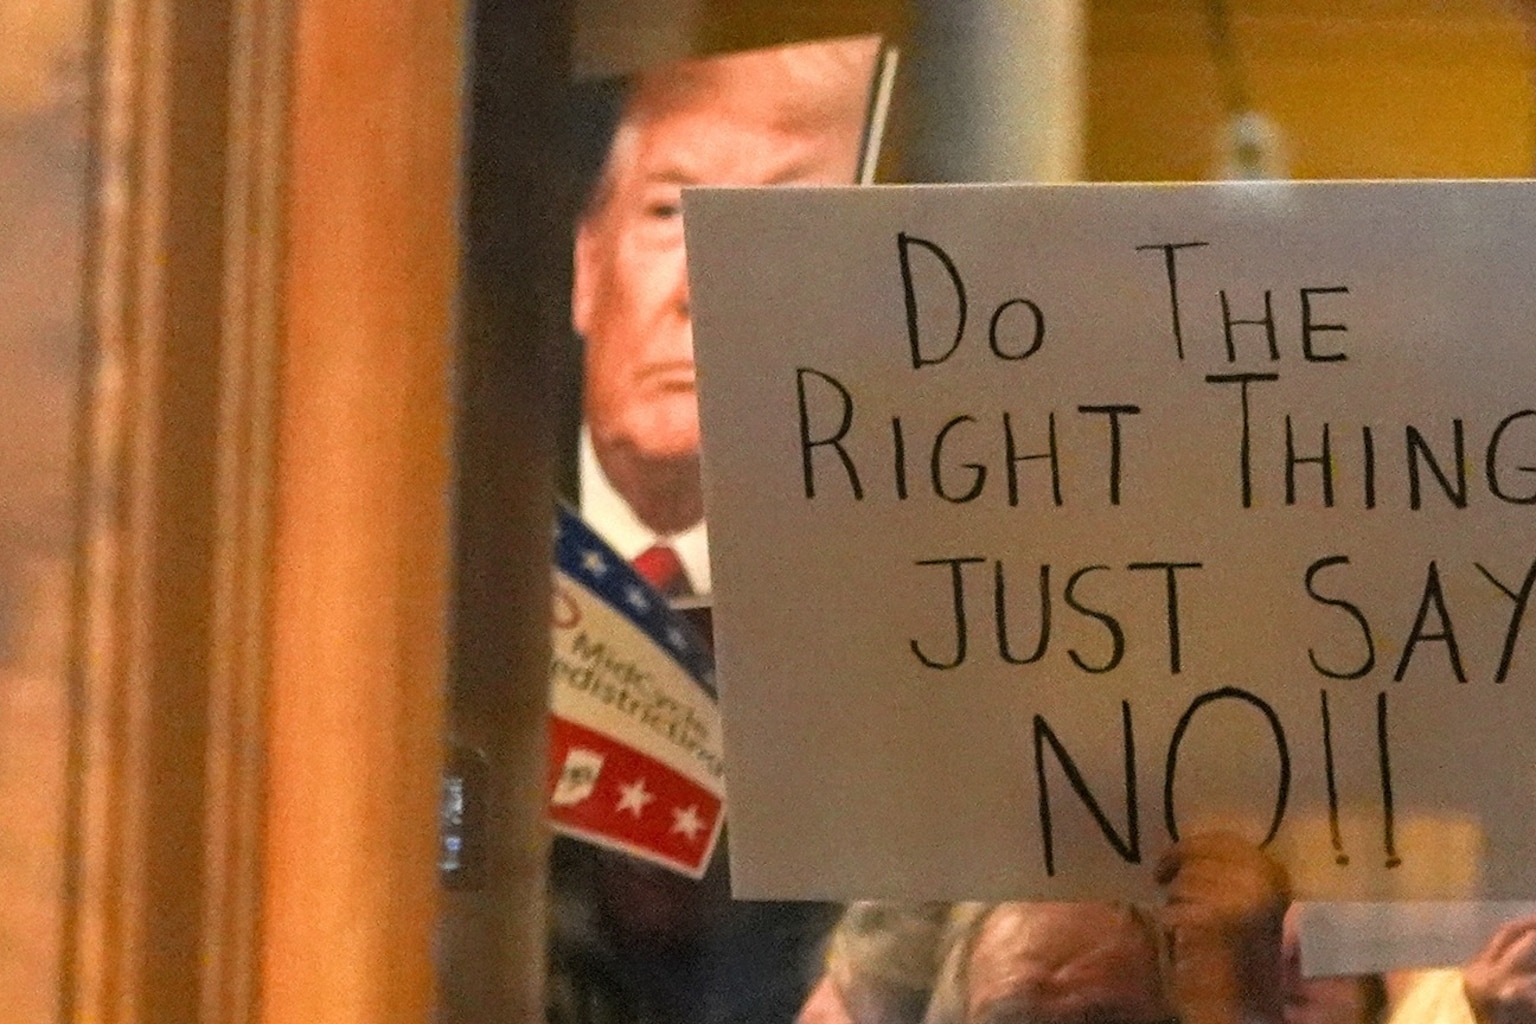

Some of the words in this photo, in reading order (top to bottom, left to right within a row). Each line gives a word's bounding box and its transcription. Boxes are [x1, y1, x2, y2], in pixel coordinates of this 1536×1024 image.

[1134, 239, 1352, 364] THE
[794, 366, 1142, 508] RIGHT
[909, 555, 1203, 676] JUST
[1032, 684, 1403, 878] NO!!
